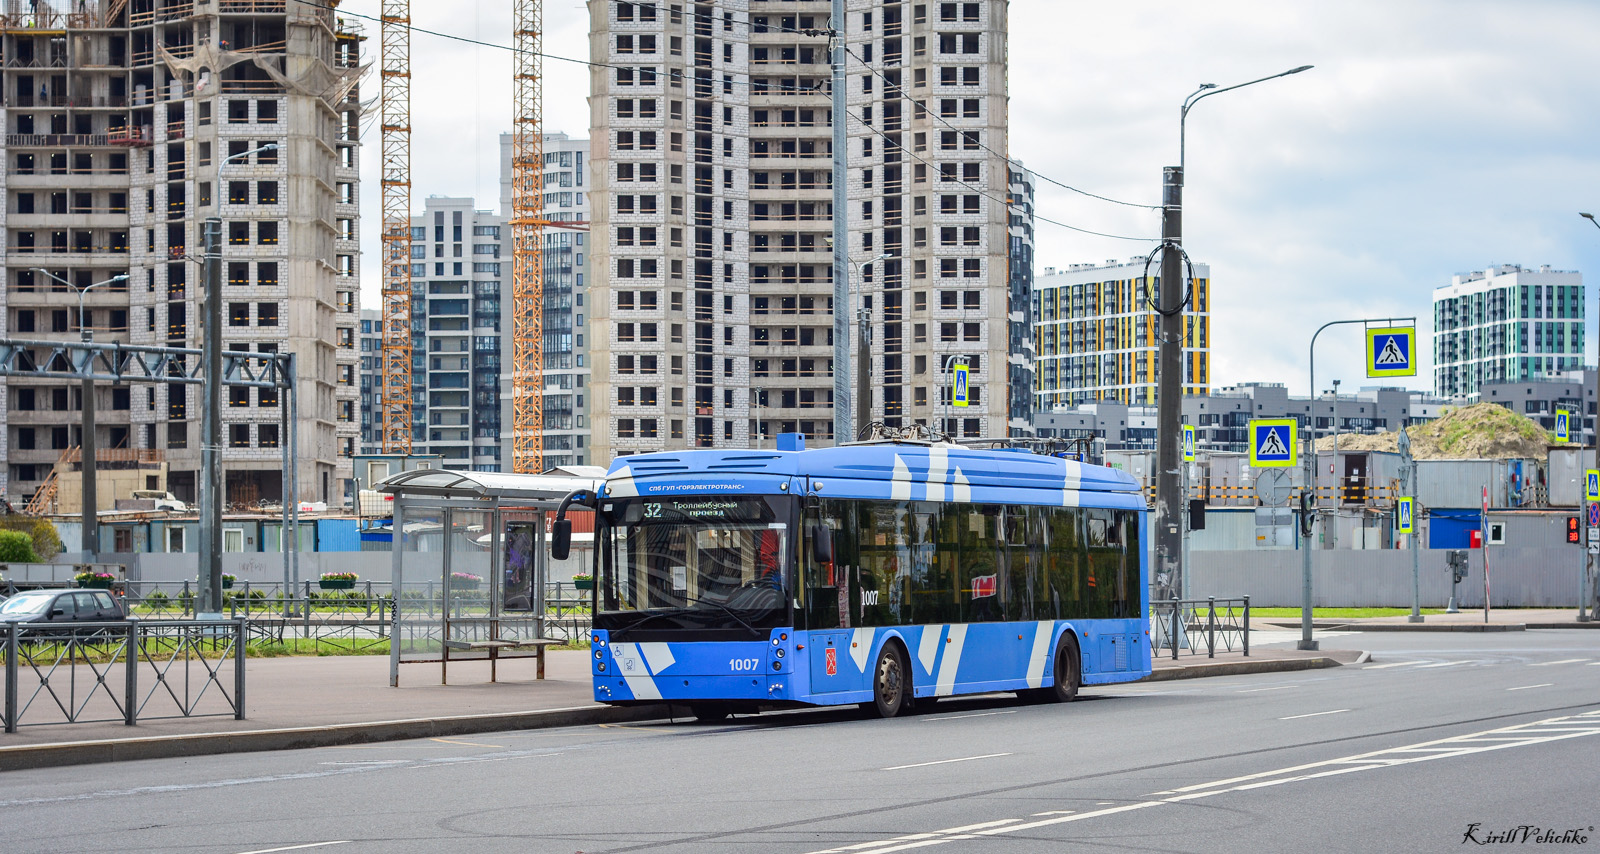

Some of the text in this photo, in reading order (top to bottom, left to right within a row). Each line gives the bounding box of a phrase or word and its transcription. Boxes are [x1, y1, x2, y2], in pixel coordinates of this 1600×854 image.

[643, 502, 662, 518] 32
[673, 501, 738, 510] Троллейбусный
[689, 509, 724, 517] проезд
[861, 590, 879, 606] 1007
[729, 658, 759, 671] 1007
